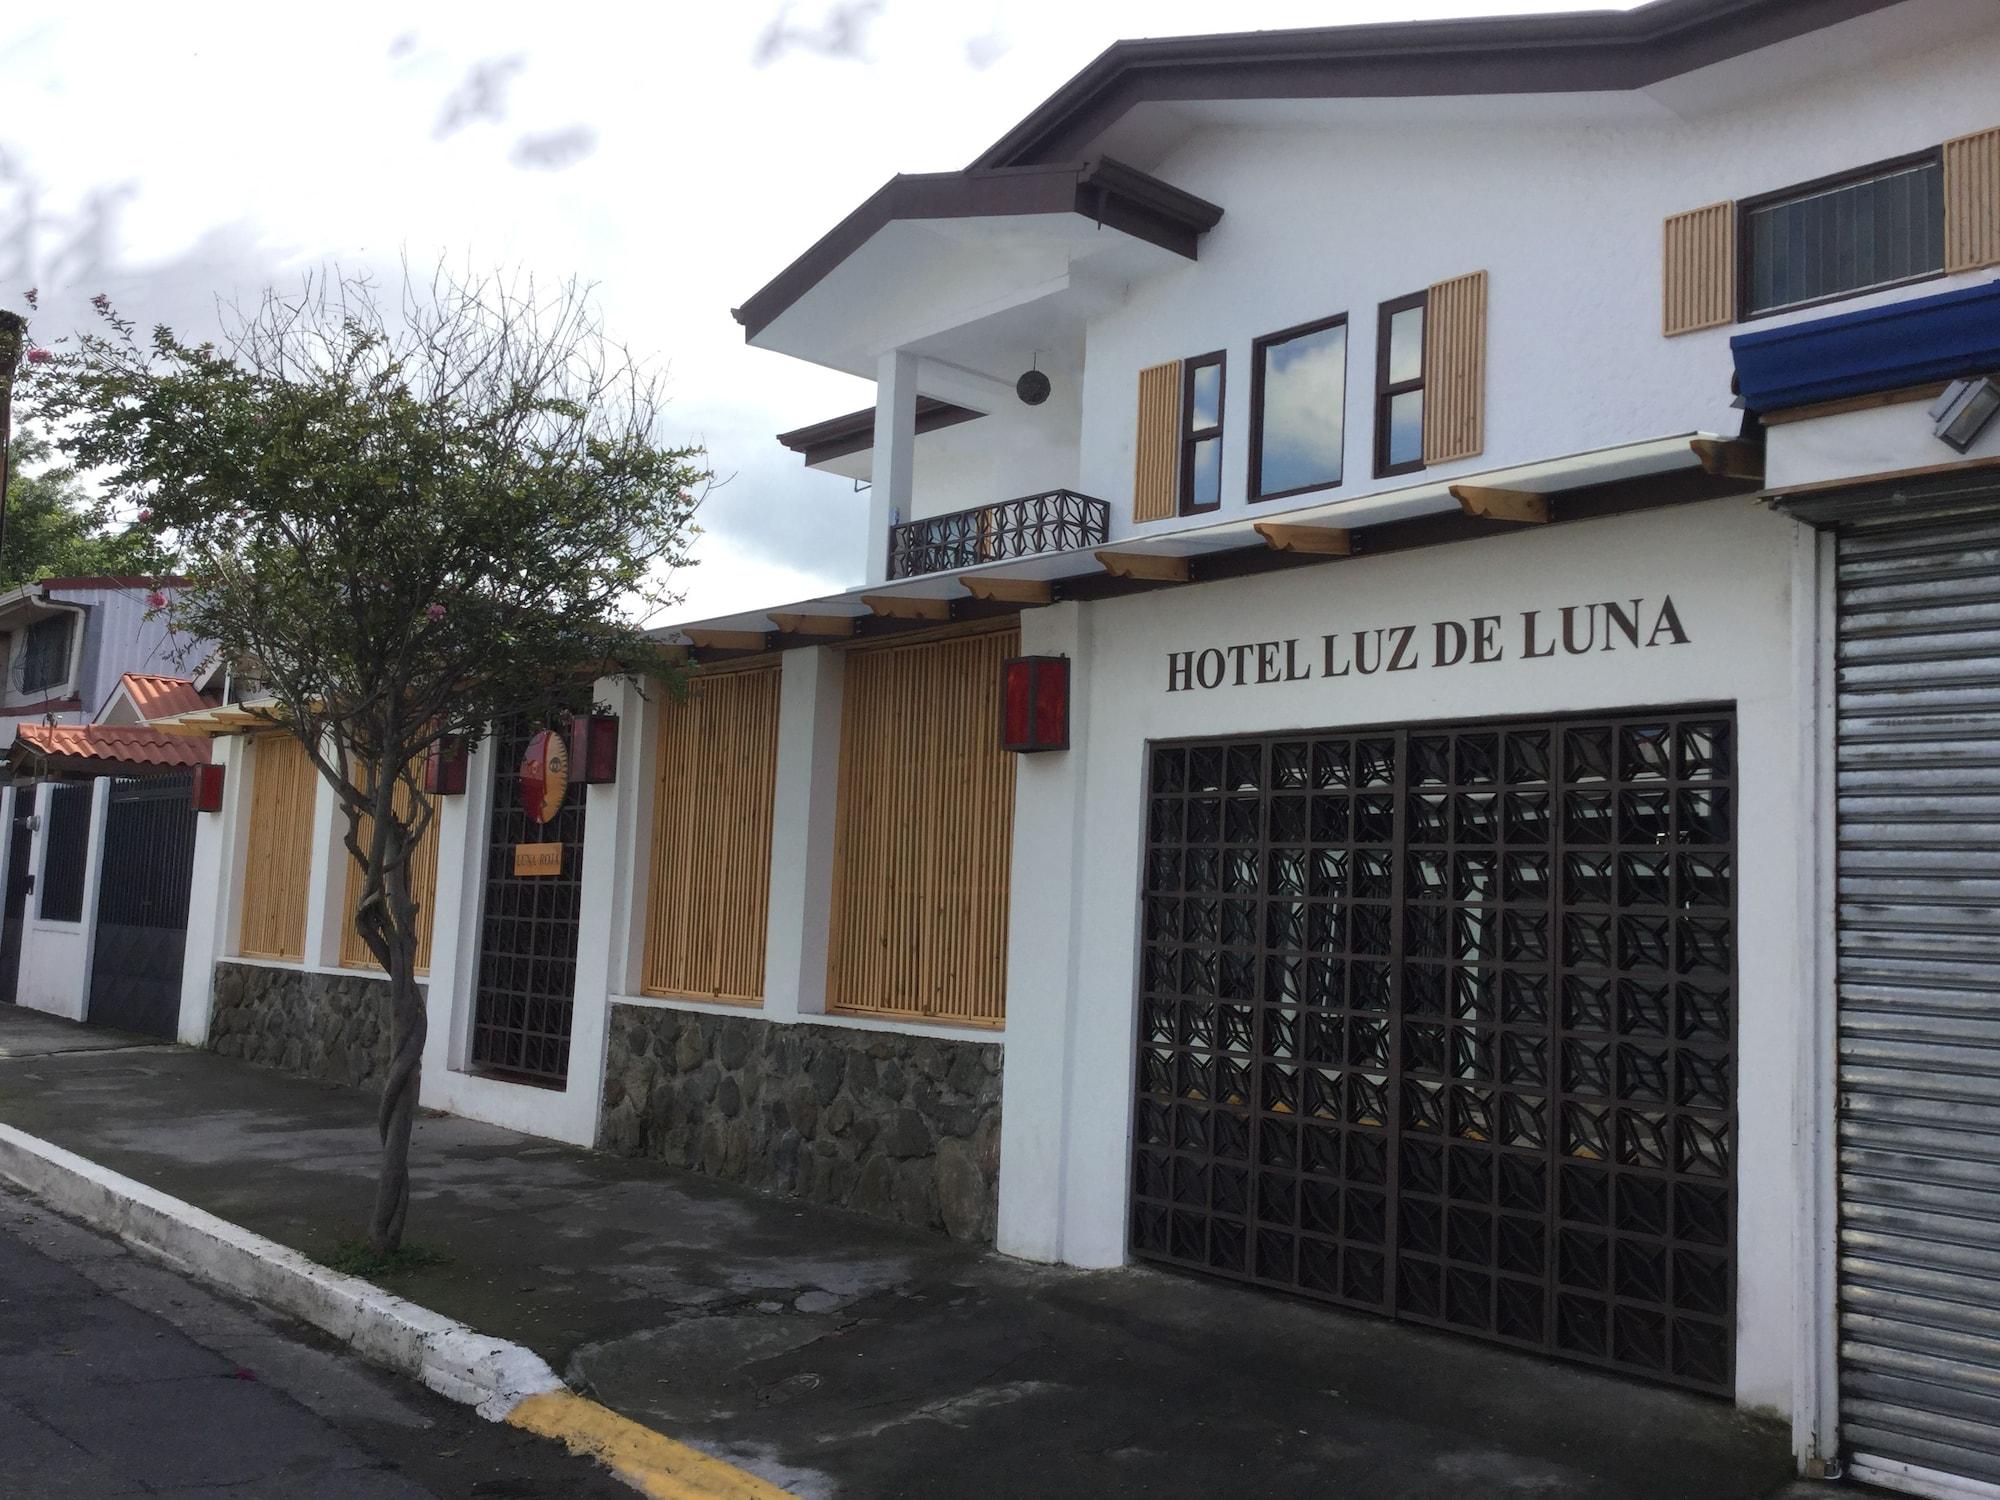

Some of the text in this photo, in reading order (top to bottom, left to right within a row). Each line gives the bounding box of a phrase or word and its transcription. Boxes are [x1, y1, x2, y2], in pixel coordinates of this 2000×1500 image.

[1165, 594, 1692, 693] HOTEL LUZ DE LUNA
[517, 854, 537, 866] LUNA
